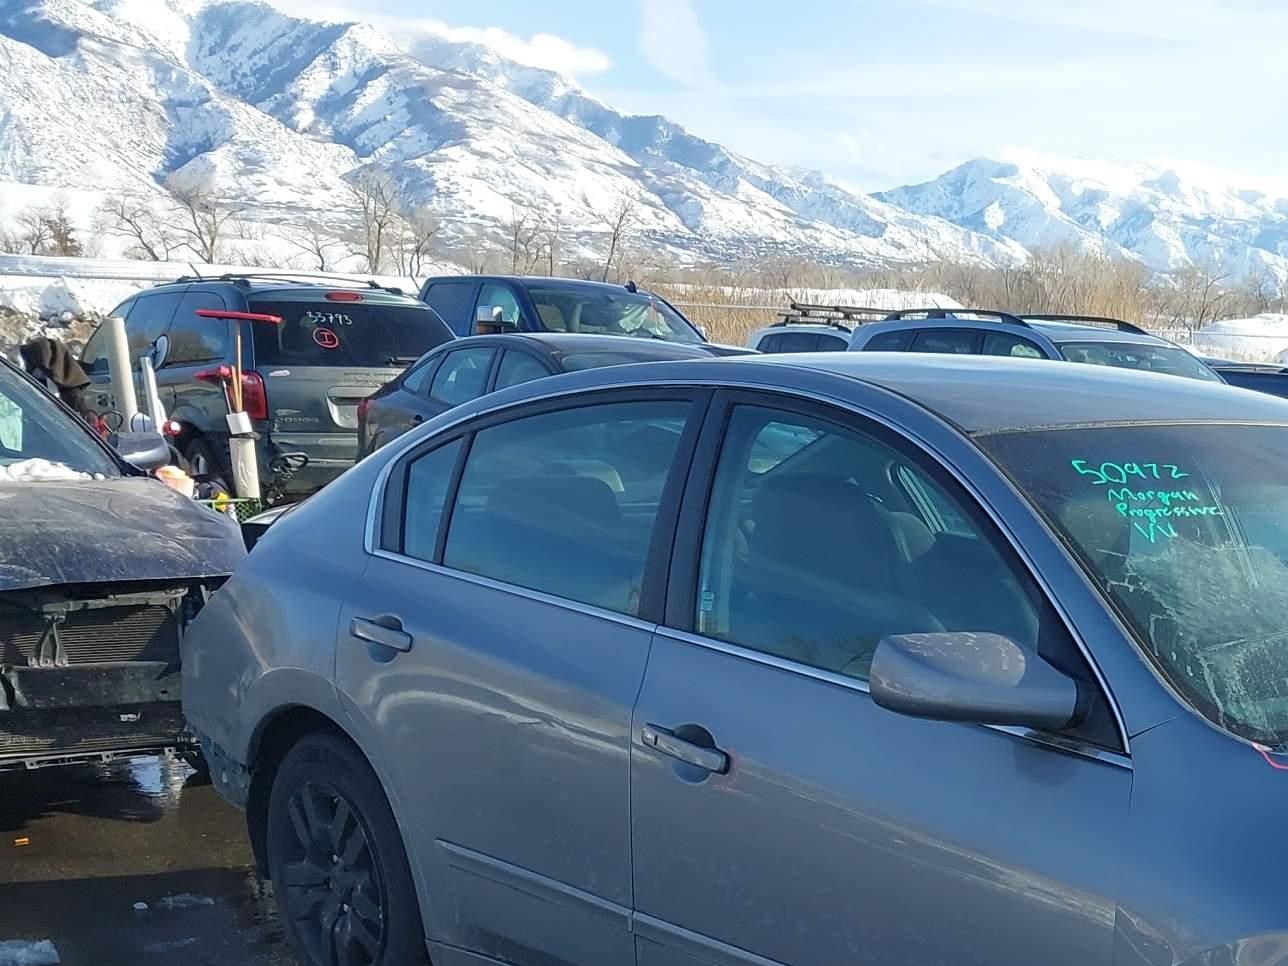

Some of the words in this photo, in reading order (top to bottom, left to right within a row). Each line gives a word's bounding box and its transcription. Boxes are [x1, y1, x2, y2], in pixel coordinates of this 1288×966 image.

[1071, 459, 1189, 485] 50972
[1107, 487, 1200, 506] Morgan
[1115, 502, 1225, 523] Progressive
